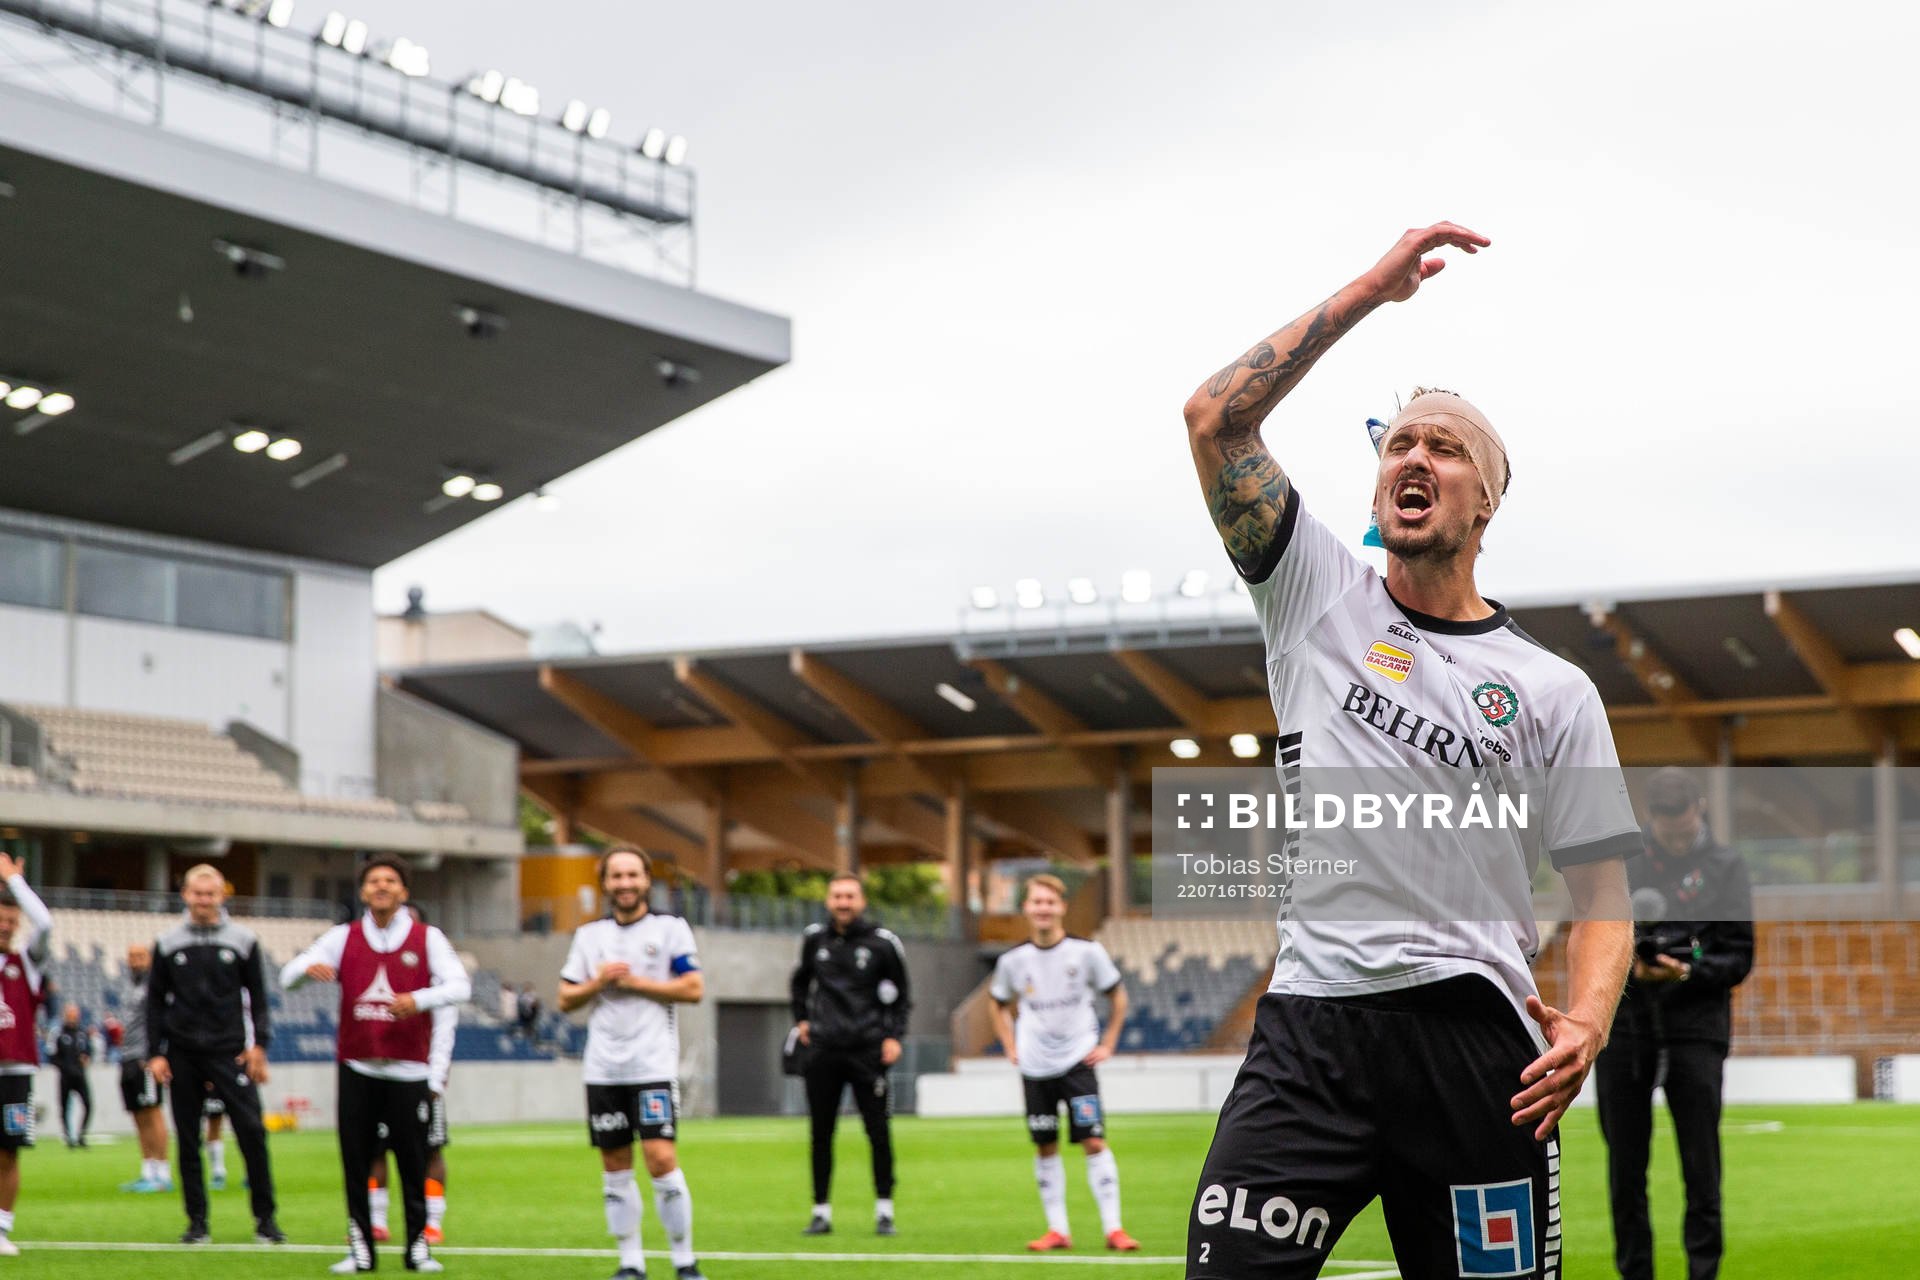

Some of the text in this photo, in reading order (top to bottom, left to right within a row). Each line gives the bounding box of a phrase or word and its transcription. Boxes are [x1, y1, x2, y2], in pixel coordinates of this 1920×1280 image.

[1387, 624, 1420, 643] SELECT
[1366, 655, 1410, 673] BAGARN
[1199, 1242, 1211, 1263] 2
